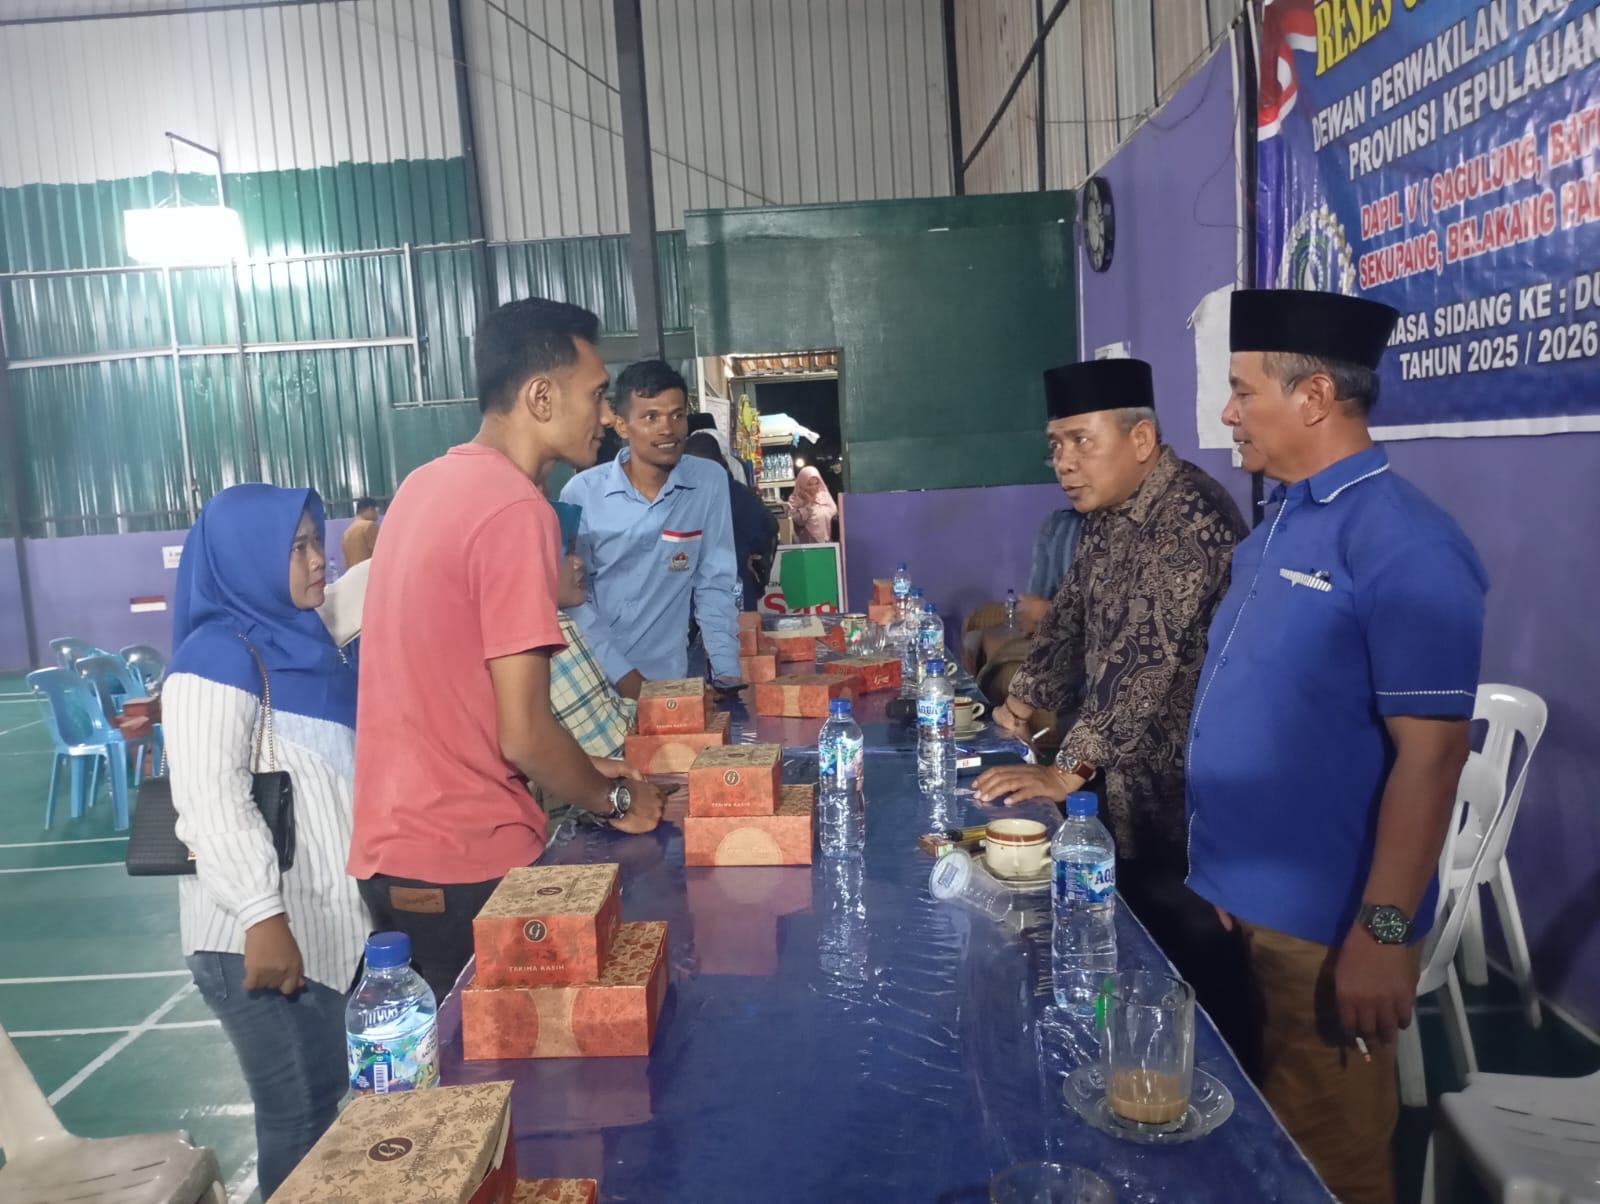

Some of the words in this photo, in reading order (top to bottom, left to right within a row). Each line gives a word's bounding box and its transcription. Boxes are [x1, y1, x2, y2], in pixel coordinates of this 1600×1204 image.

[1312, 86, 1365, 152] DEWAN
[1371, 0, 1508, 117] PERWAKILAN
[1349, 99, 1436, 180] PROVINSI
[1443, 7, 1600, 134] KEPULAUAN
[1361, 191, 1403, 240] DAPIL
[1431, 133, 1542, 214] SAGULUNG,
[1548, 107, 1600, 169] BAT
[1360, 230, 1443, 289] SEKUPANG,
[1447, 189, 1555, 263] BELAKANG
[1399, 344, 1461, 380] TAHUN
[1467, 334, 1518, 372] 2025
[1537, 320, 1598, 363] 2026
[1434, 292, 1512, 337] SIDANG
[1519, 282, 1552, 321] KE
